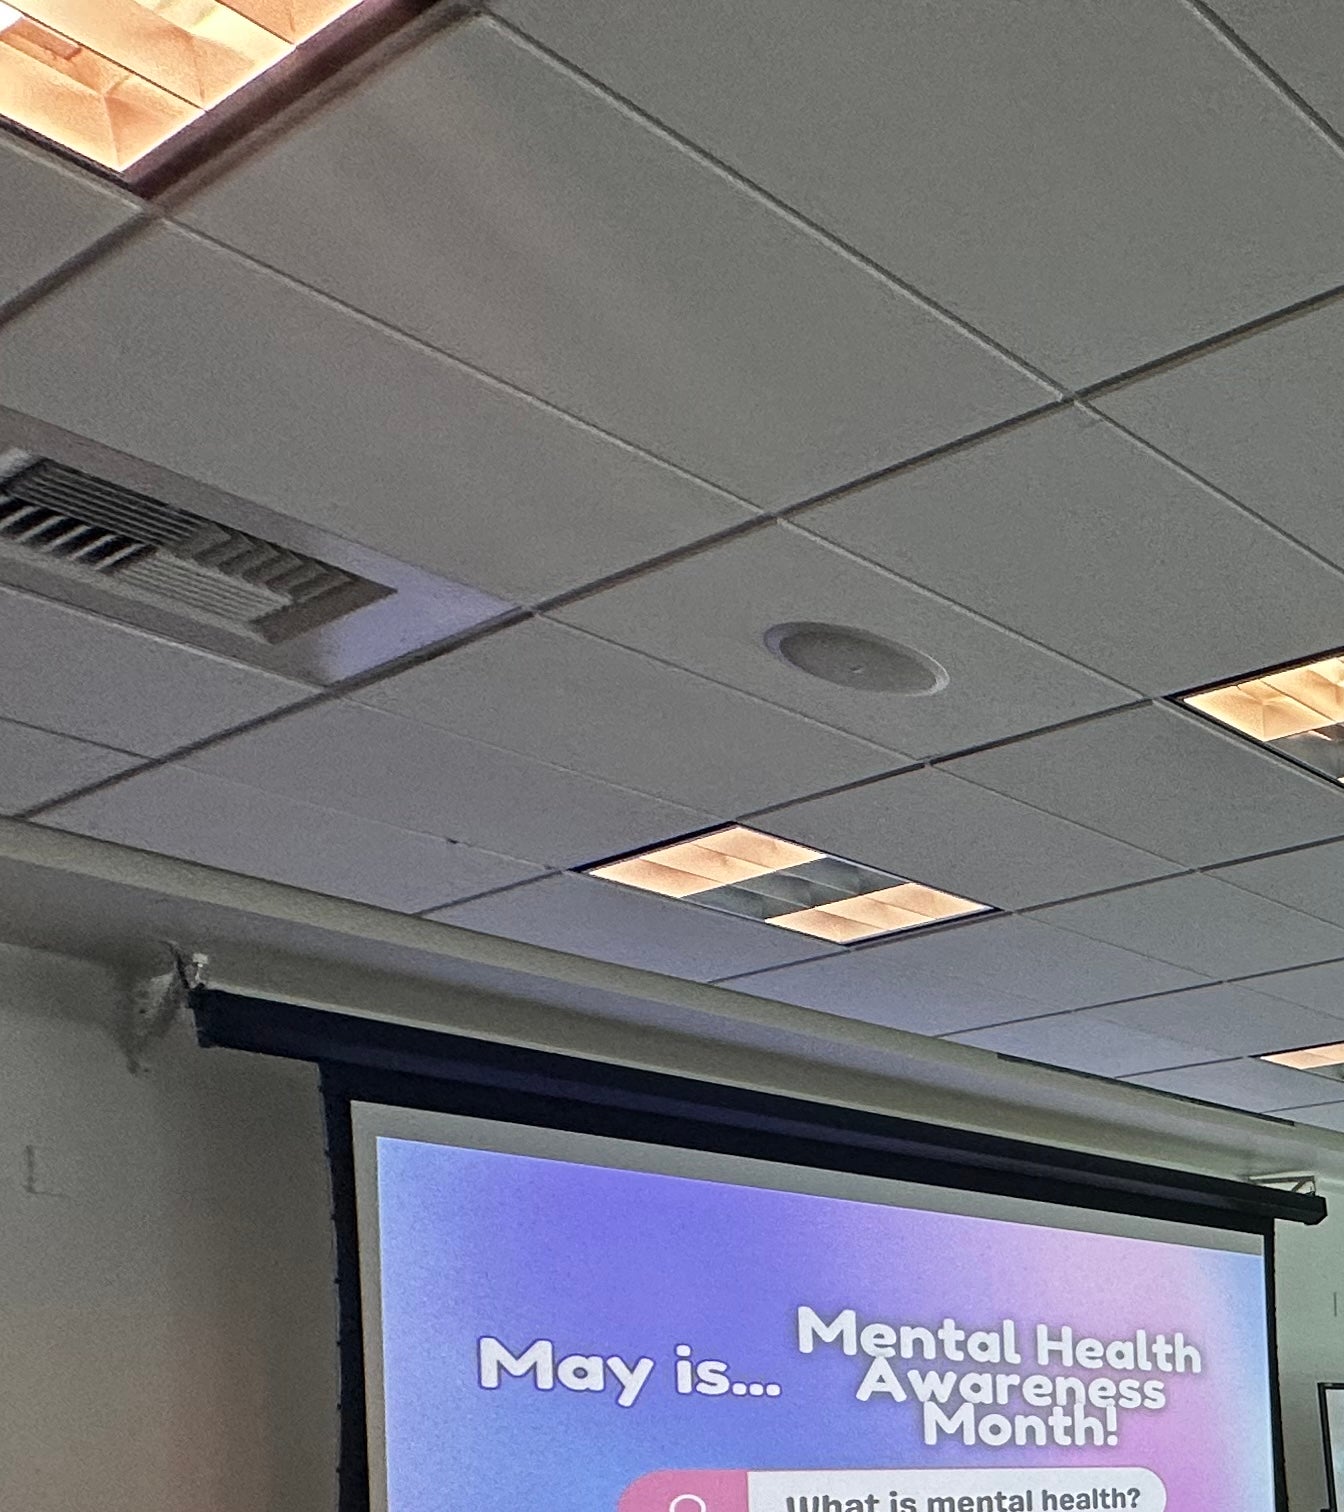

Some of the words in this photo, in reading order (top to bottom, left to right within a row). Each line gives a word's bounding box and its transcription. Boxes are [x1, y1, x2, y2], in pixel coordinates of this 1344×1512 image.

[797, 1305, 1020, 1365] Mental
[1036, 1323, 1202, 1375] Health
[478, 1336, 654, 1408] May
[674, 1344, 782, 1399] is...
[855, 1356, 1167, 1411] Awareness
[923, 1402, 1120, 1447] Month!
[1041, 1486, 1141, 1512] health?
